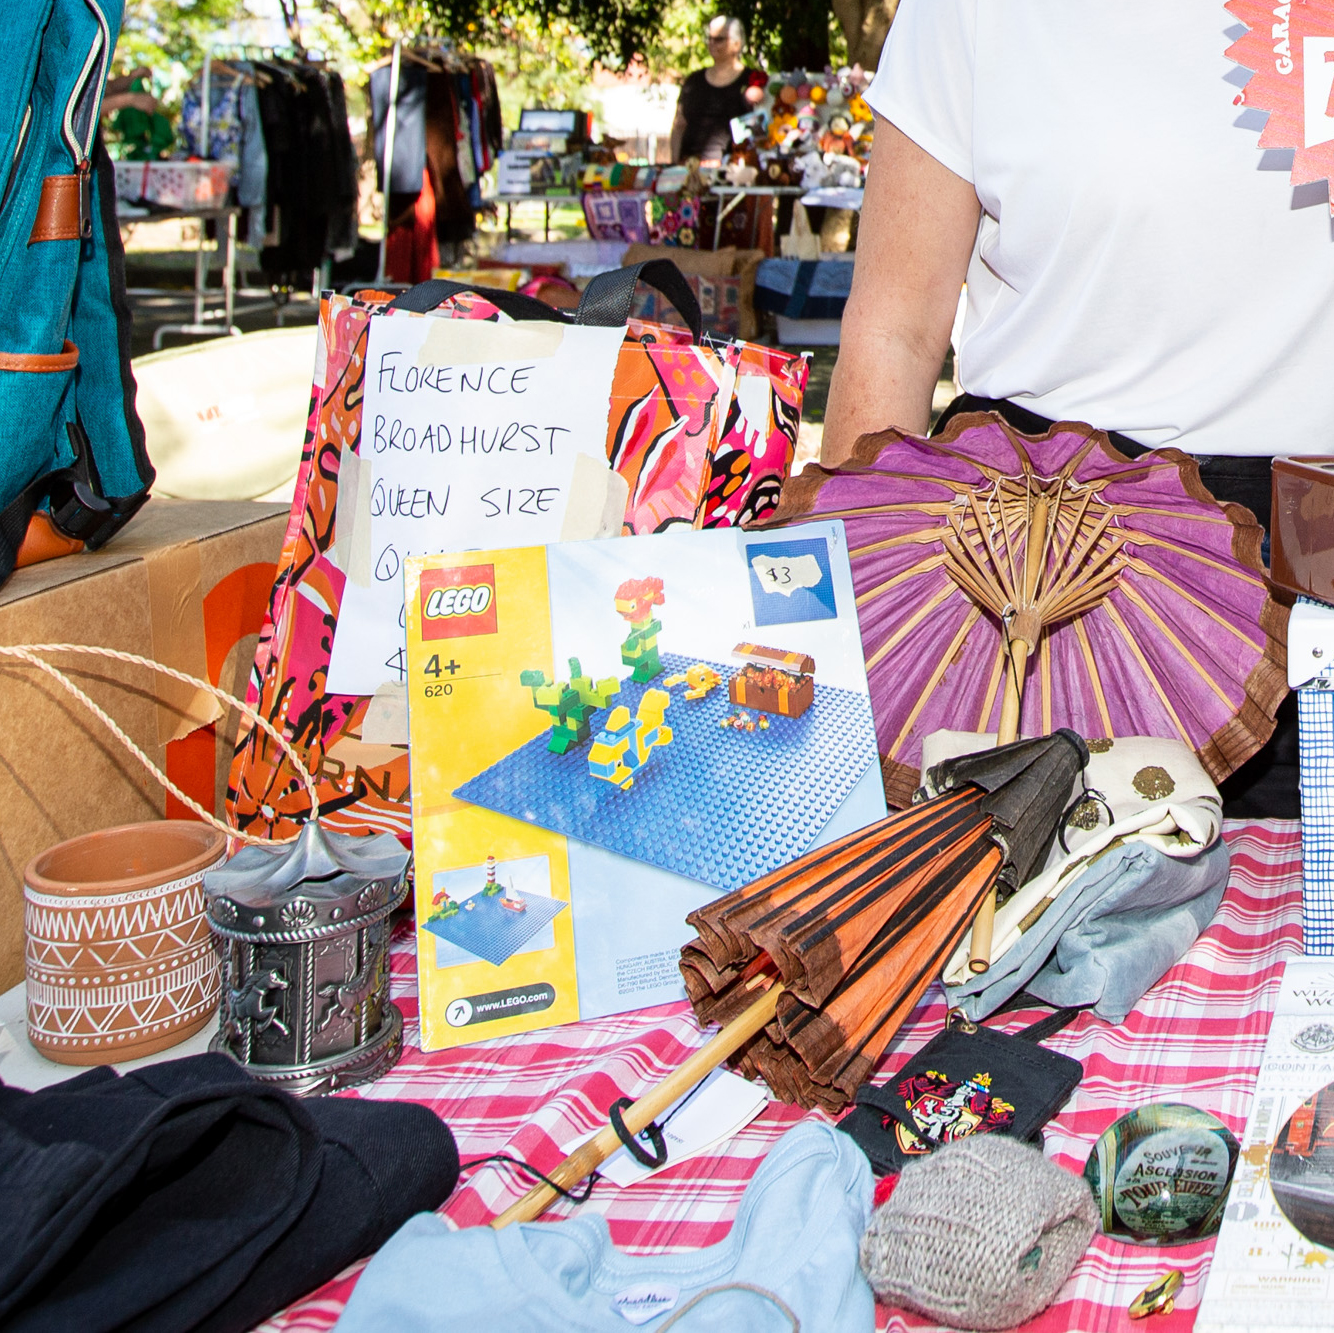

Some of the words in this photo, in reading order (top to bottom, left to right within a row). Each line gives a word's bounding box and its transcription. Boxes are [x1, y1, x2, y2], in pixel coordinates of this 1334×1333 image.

[378, 351, 537, 395] FLORENCE
[373, 415, 571, 454] BROADHURST
[370, 478, 451, 518] QUEEN
[480, 487, 560, 517] SIZE
[426, 584, 492, 618] LEGO
[424, 654, 461, 678] 4+
[425, 684, 453, 698] 620
[616, 954, 648, 965] Components
[477, 990, 548, 1014] www.LEGO.com
[1174, 1179, 1217, 1196] EIFFEL
